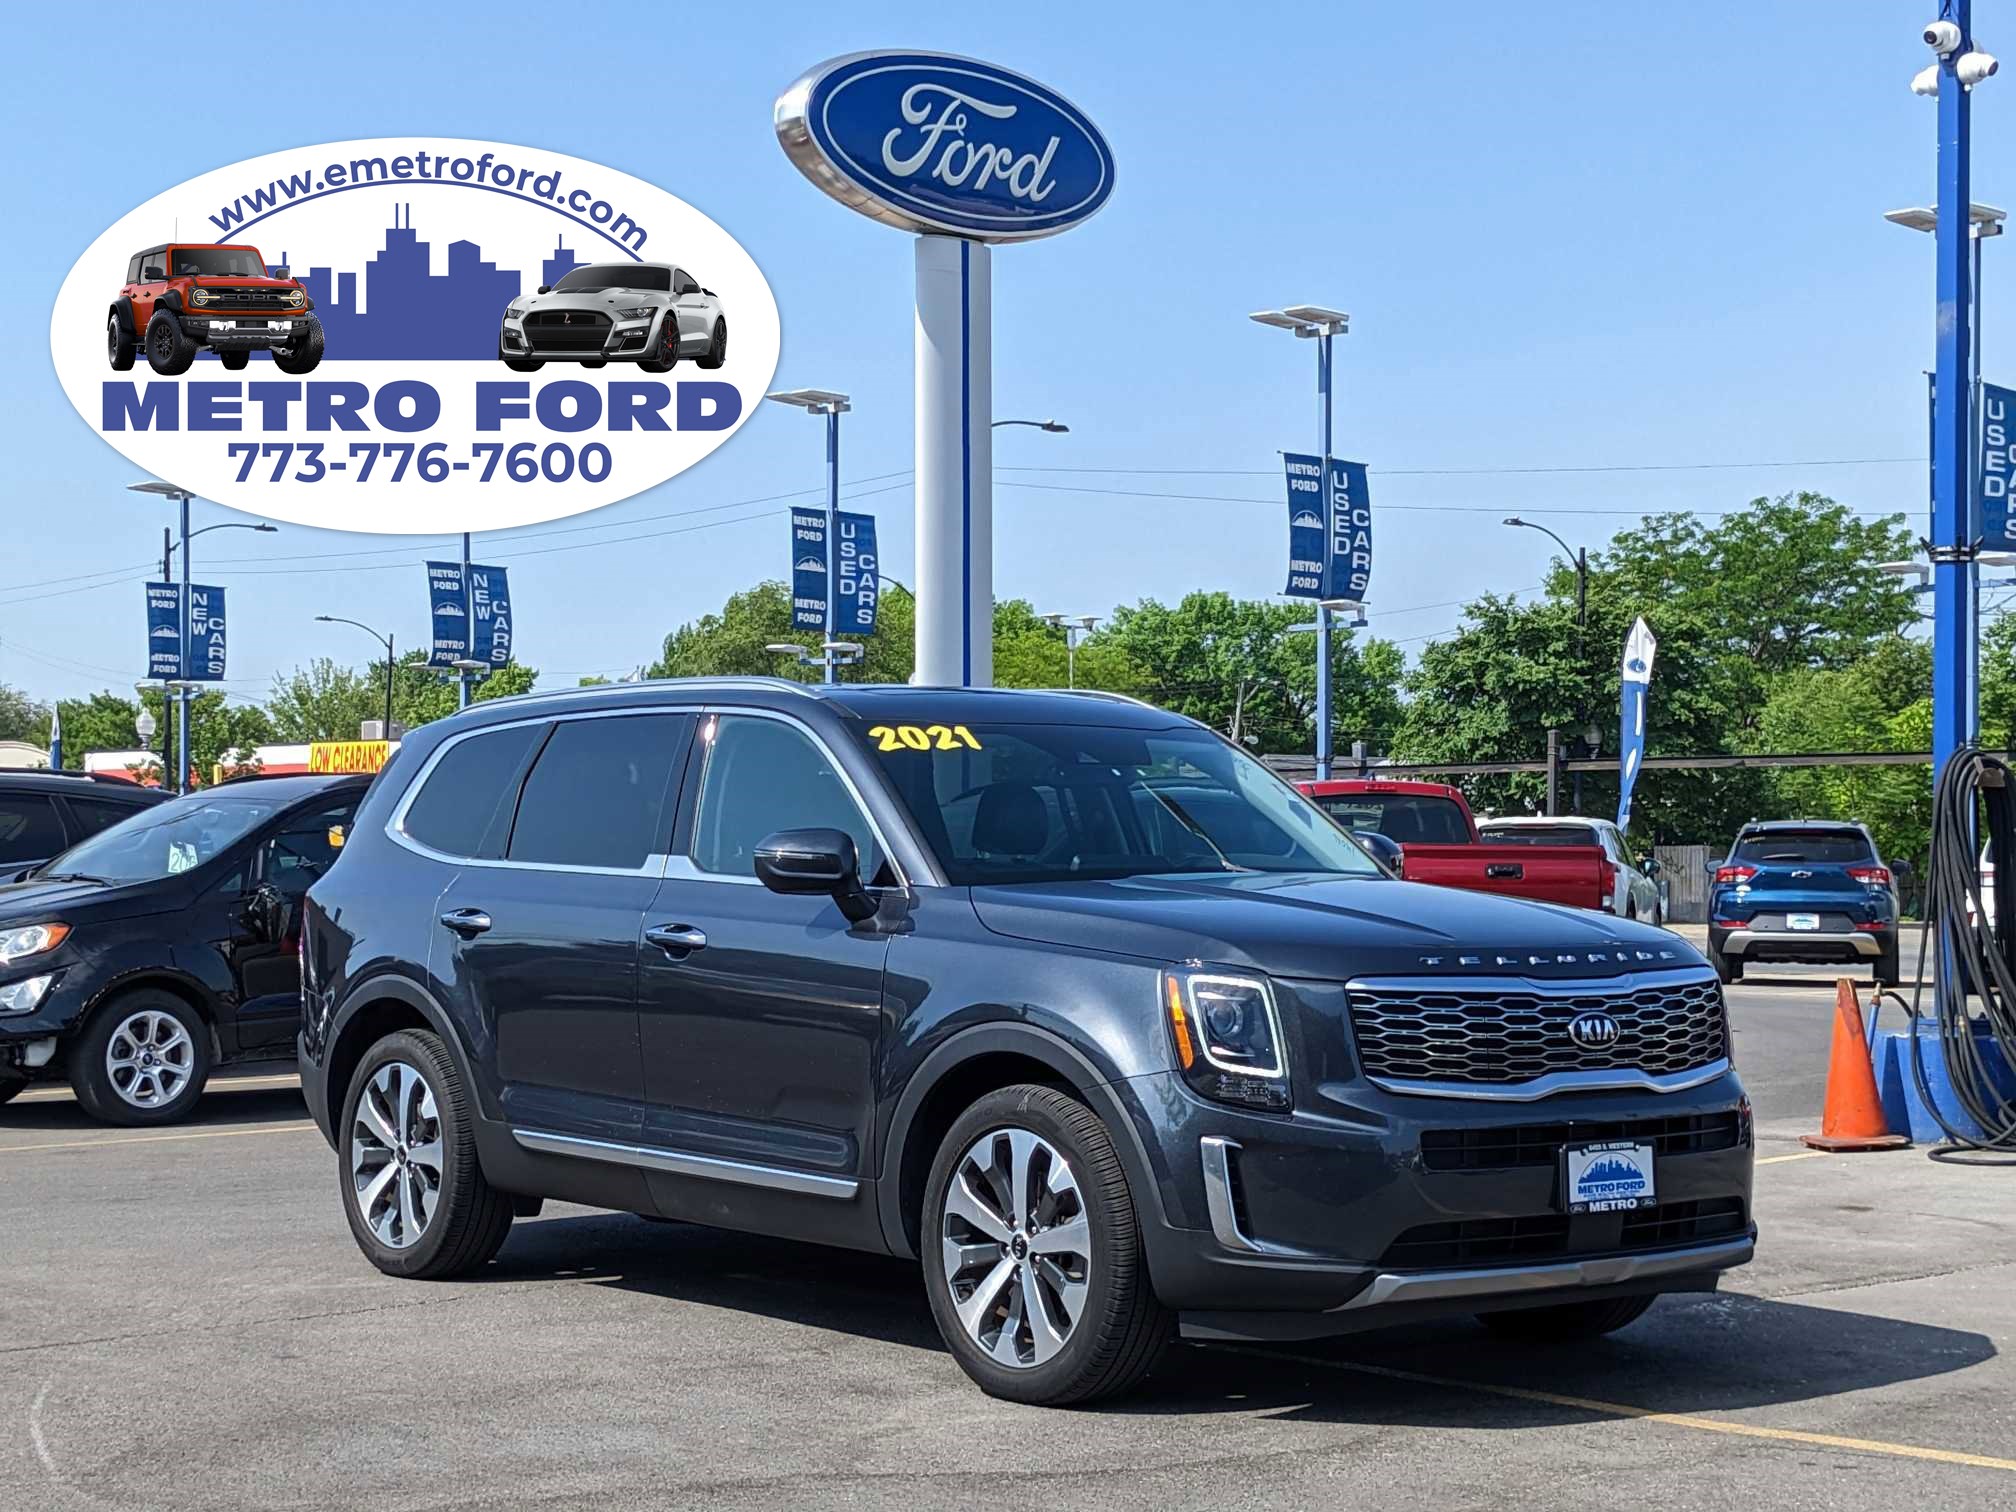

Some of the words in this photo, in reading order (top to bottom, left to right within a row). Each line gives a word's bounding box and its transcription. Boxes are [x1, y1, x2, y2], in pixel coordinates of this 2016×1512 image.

[882, 83, 1061, 201] Ford
[1984, 398, 2006, 498] USED
[1287, 462, 1321, 477] METRO
[1291, 479, 1319, 492] FORD
[1333, 470, 1351, 555] USED
[793, 515, 825, 528] METRO
[797, 529, 823, 541] FORD
[1350, 509, 1371, 591] CARS
[840, 522, 856, 595] USED
[1291, 560, 1323, 573] METRO
[429, 568, 460, 579] METRO
[433, 581, 459, 590] FORD
[857, 554, 875, 624] CARS
[1292, 576, 1319, 589] FORD
[148, 589, 178, 598] METRO
[473, 573, 490, 620] NEW
[151, 599, 175, 608] FORD
[794, 598, 826, 610] METRO
[192, 592, 208, 635] NEW
[797, 612, 823, 624] FORD
[491, 600, 509, 662] CARS
[208, 618, 225, 674] CARS
[435, 640, 464, 649] METRO
[436, 652, 461, 661] FORD
[153, 664, 177, 673] FORD
[868, 725, 982, 752] 2021
[311, 746, 331, 772] LOW
[333, 744, 386, 773] CLEARANCE
[1578, 1019, 1616, 1041] KIA
[1578, 1182, 1615, 1194] METRO
[1616, 1181, 1646, 1191] FORD
[1589, 1198, 1638, 1212] METRO
